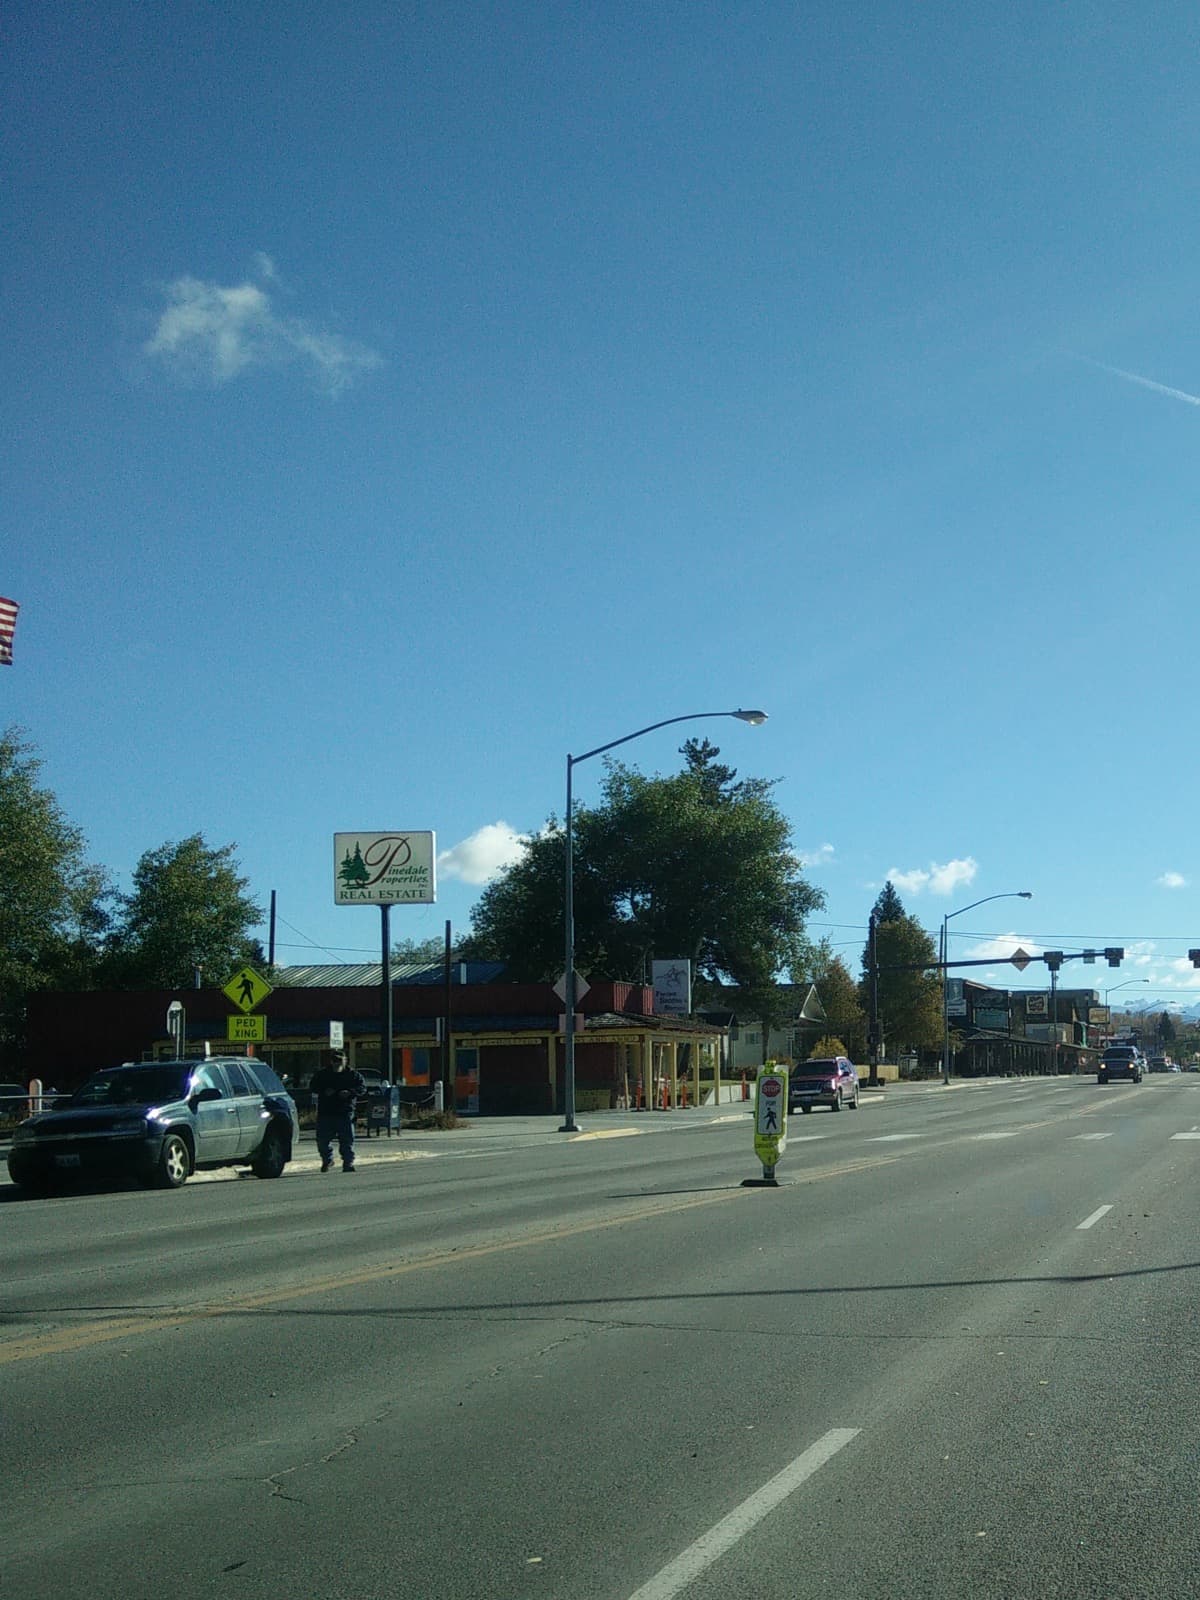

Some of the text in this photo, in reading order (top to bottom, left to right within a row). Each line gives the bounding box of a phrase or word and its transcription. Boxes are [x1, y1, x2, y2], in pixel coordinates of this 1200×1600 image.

[339, 889, 426, 899] REAL ESTATE
[236, 1018, 256, 1027] PED
[235, 1029, 258, 1039] XING
[763, 1085, 782, 1093] STOP
